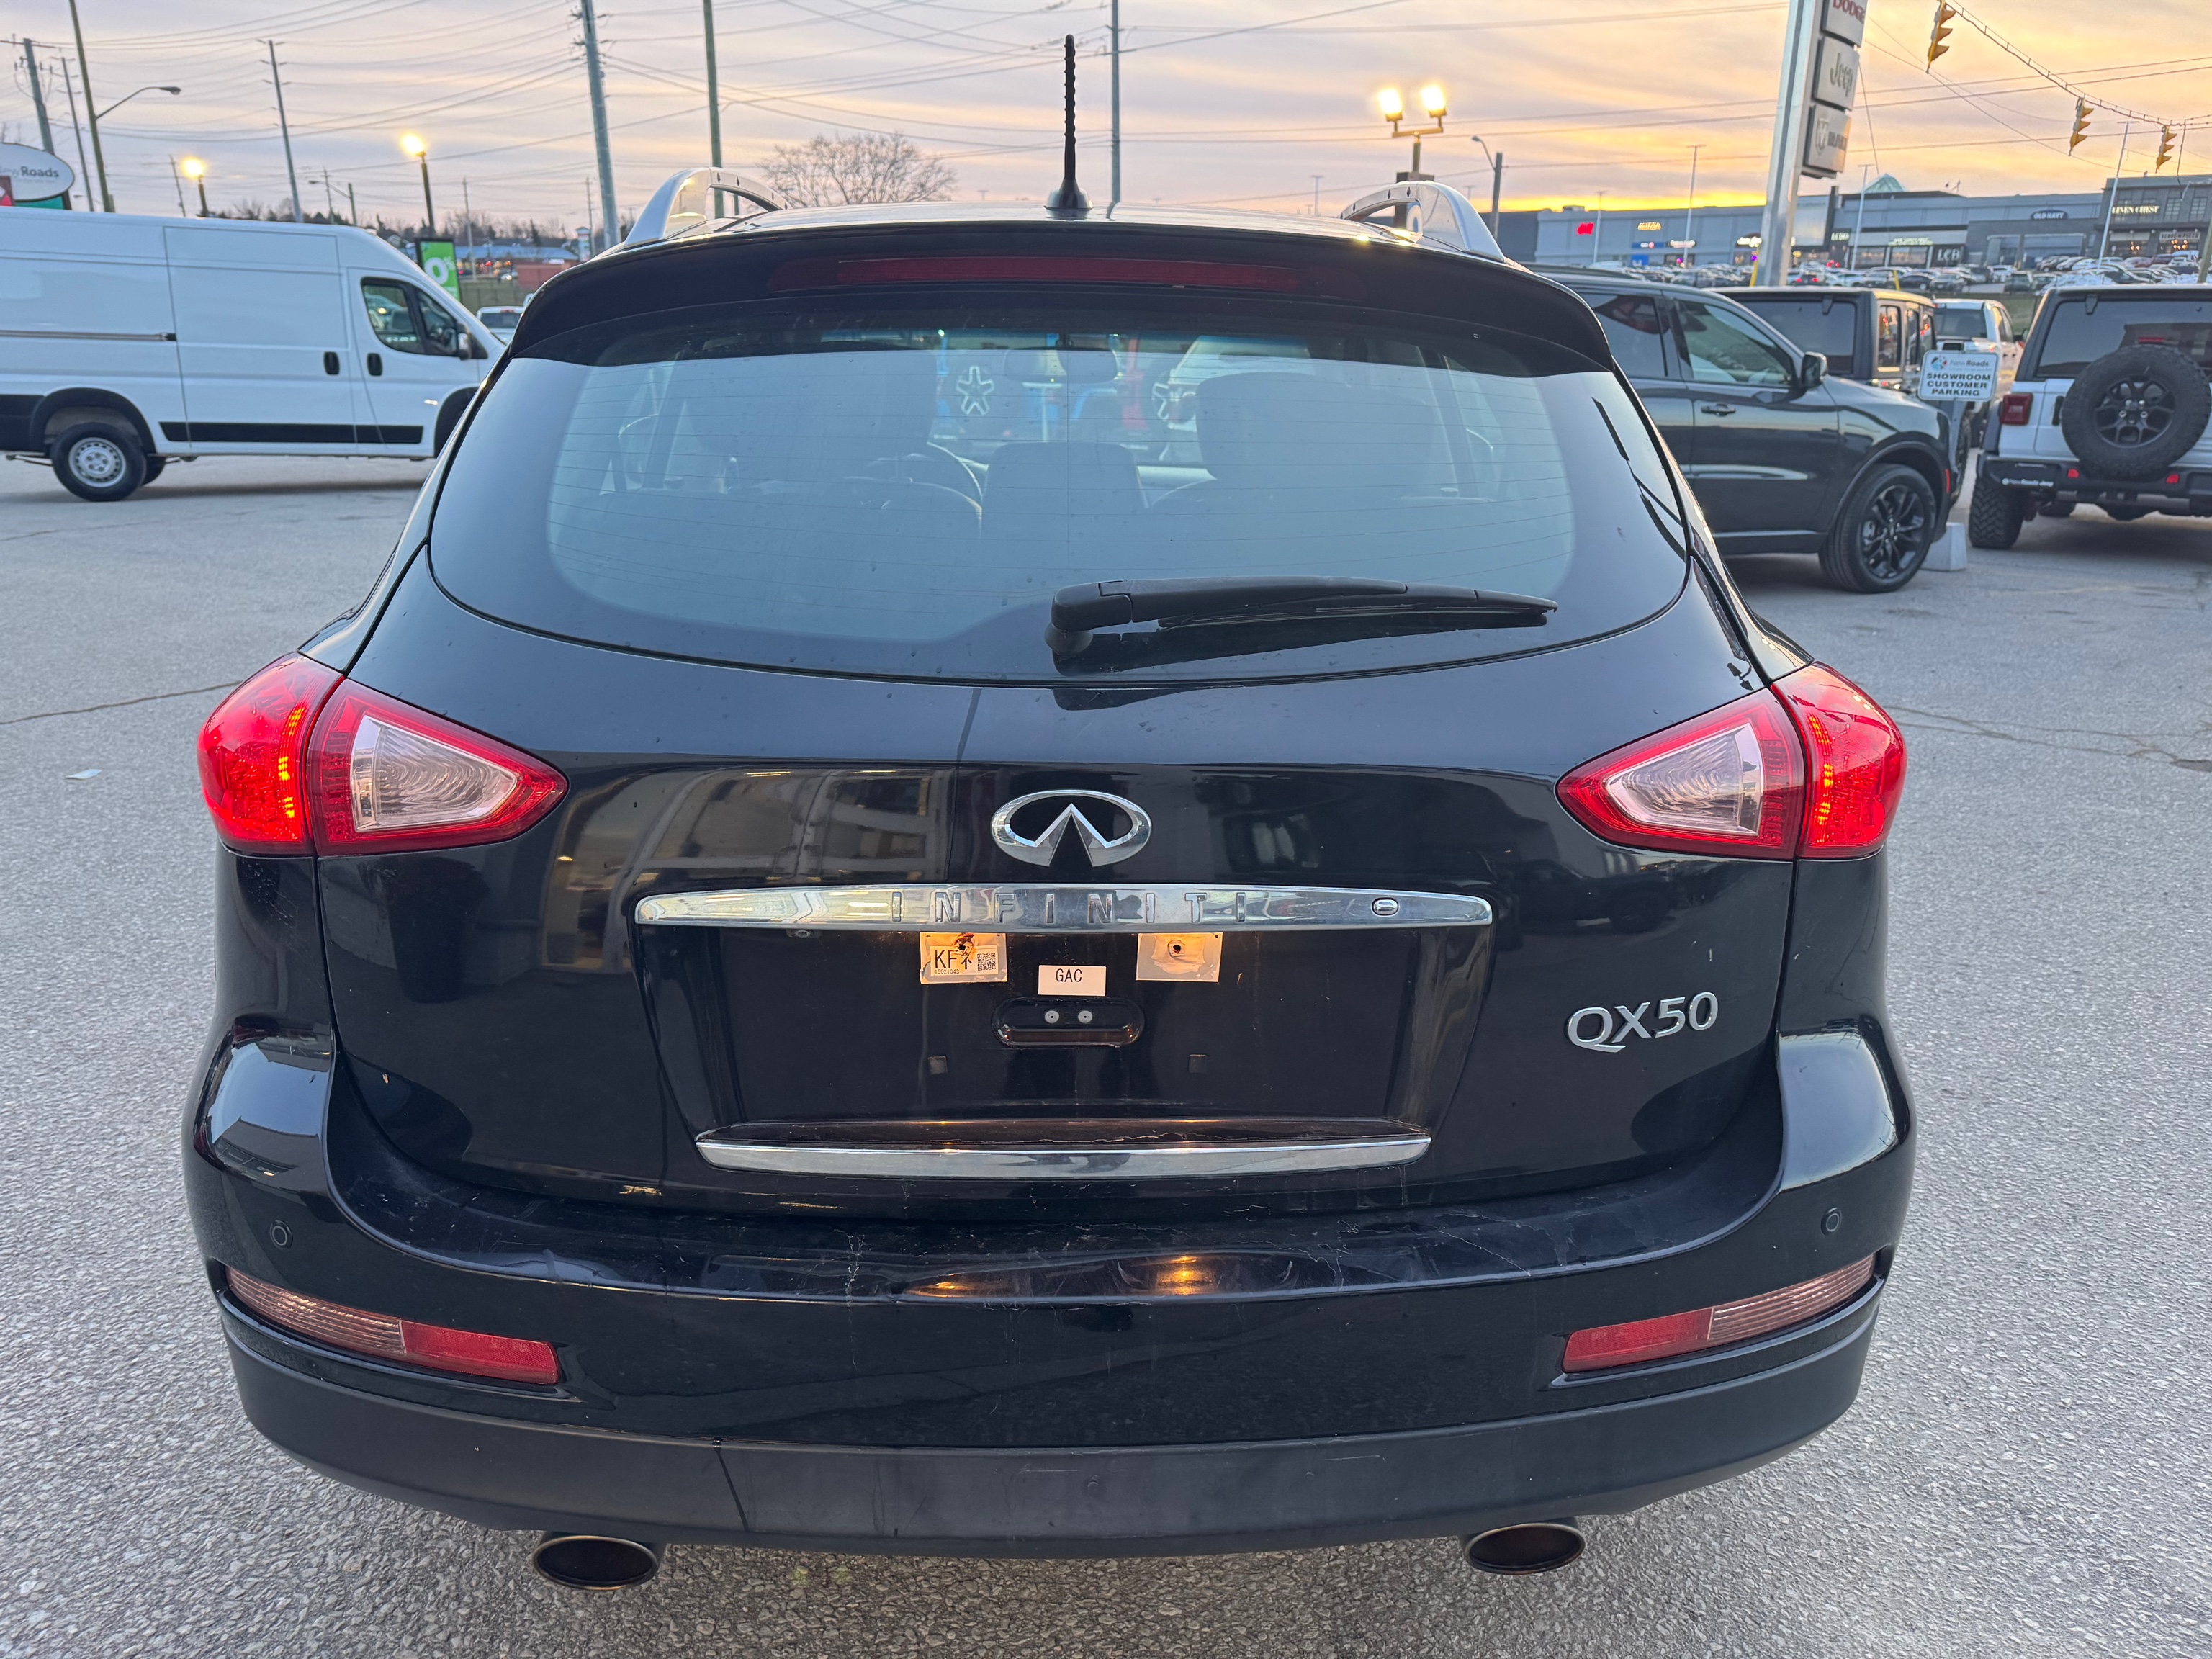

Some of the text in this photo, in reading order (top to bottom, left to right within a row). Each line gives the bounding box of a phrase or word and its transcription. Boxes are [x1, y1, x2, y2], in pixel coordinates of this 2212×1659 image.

[1830, 53, 1853, 97] Jeep
[891, 891, 1246, 924] INFINITI
[1056, 968, 1082, 983] GAC
[1565, 992, 1718, 1053] QX50
